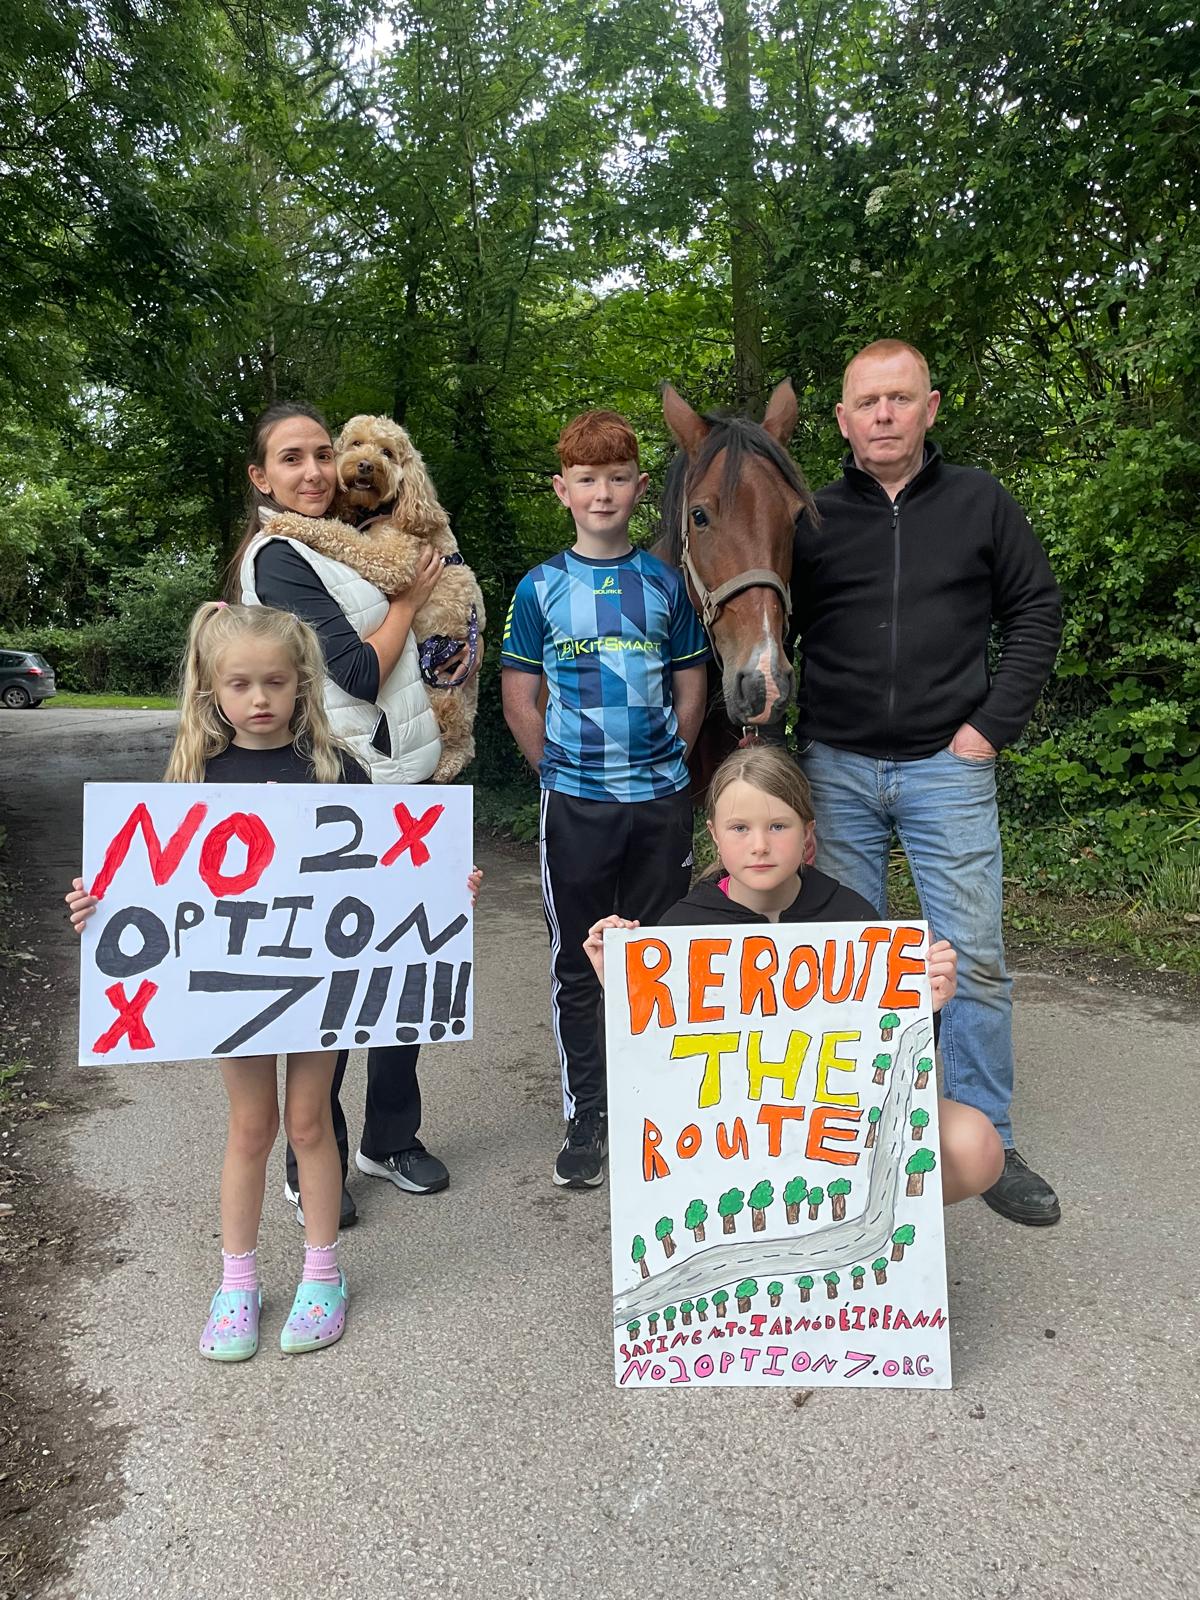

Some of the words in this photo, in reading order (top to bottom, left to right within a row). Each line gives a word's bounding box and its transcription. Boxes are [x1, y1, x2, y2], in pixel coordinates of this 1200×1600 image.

[89, 801, 276, 898] NO
[299, 805, 378, 873] 2
[95, 896, 469, 978] OPTION
[625, 926, 926, 1035] REROUTE
[669, 1029, 862, 1109] THE
[643, 1104, 864, 1181] ROUTE
[619, 1330, 702, 1363] SAYING
